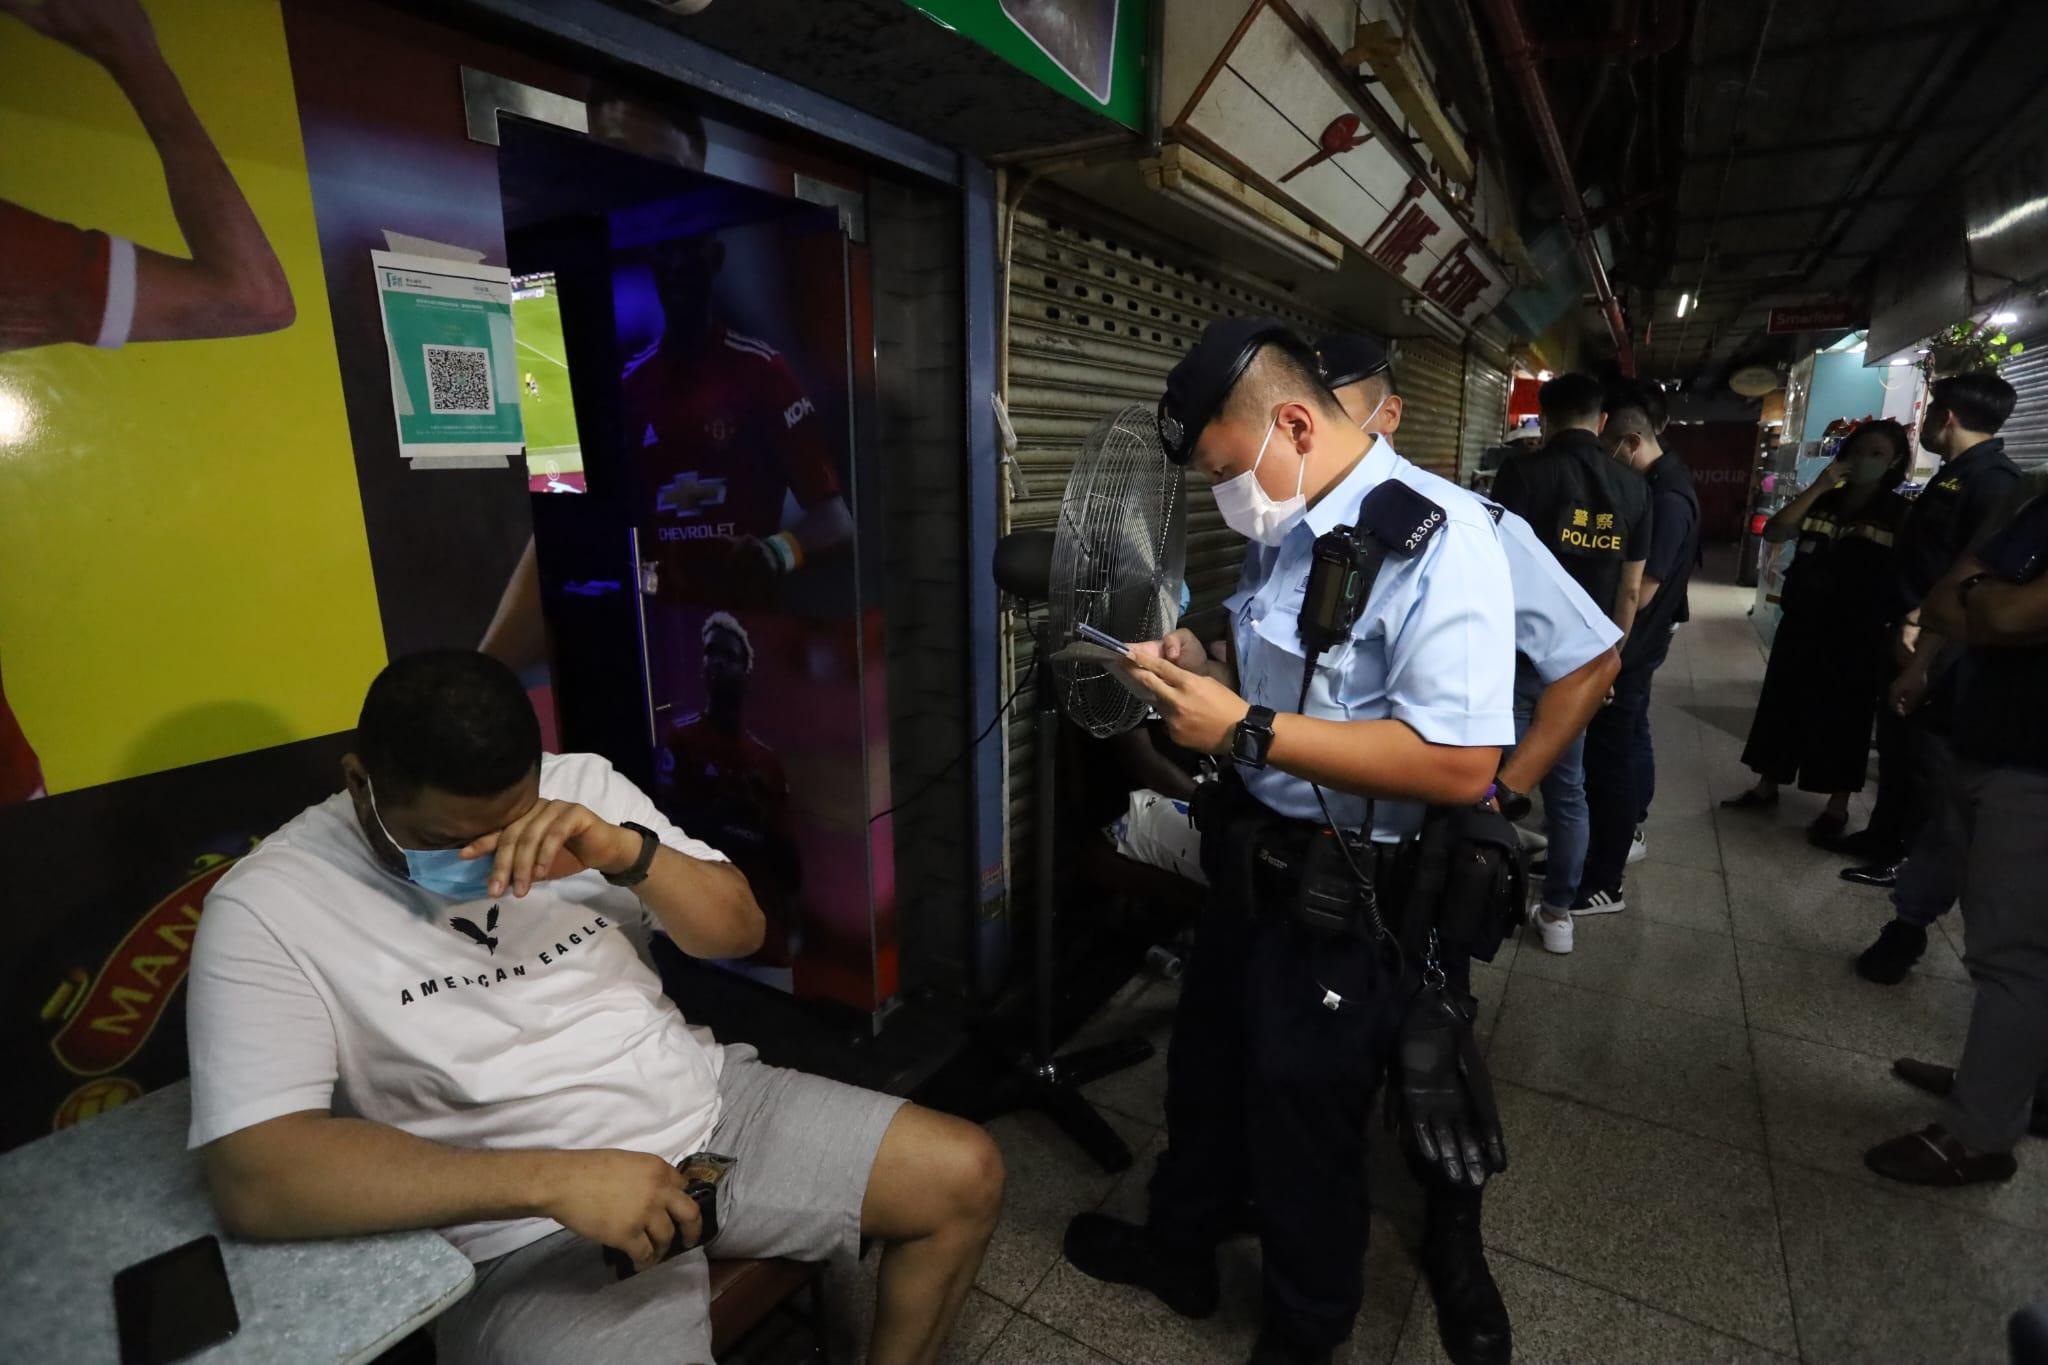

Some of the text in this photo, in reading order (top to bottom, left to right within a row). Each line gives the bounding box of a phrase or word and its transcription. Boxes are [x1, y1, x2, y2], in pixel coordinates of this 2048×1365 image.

[1692, 469, 1746, 485] NJOUR
[658, 522, 736, 542] CHEVROLET
[1404, 510, 1441, 551] 28306
[1561, 527, 1622, 550] POLICE
[400, 916, 608, 1006] AMECAN EAGLE
